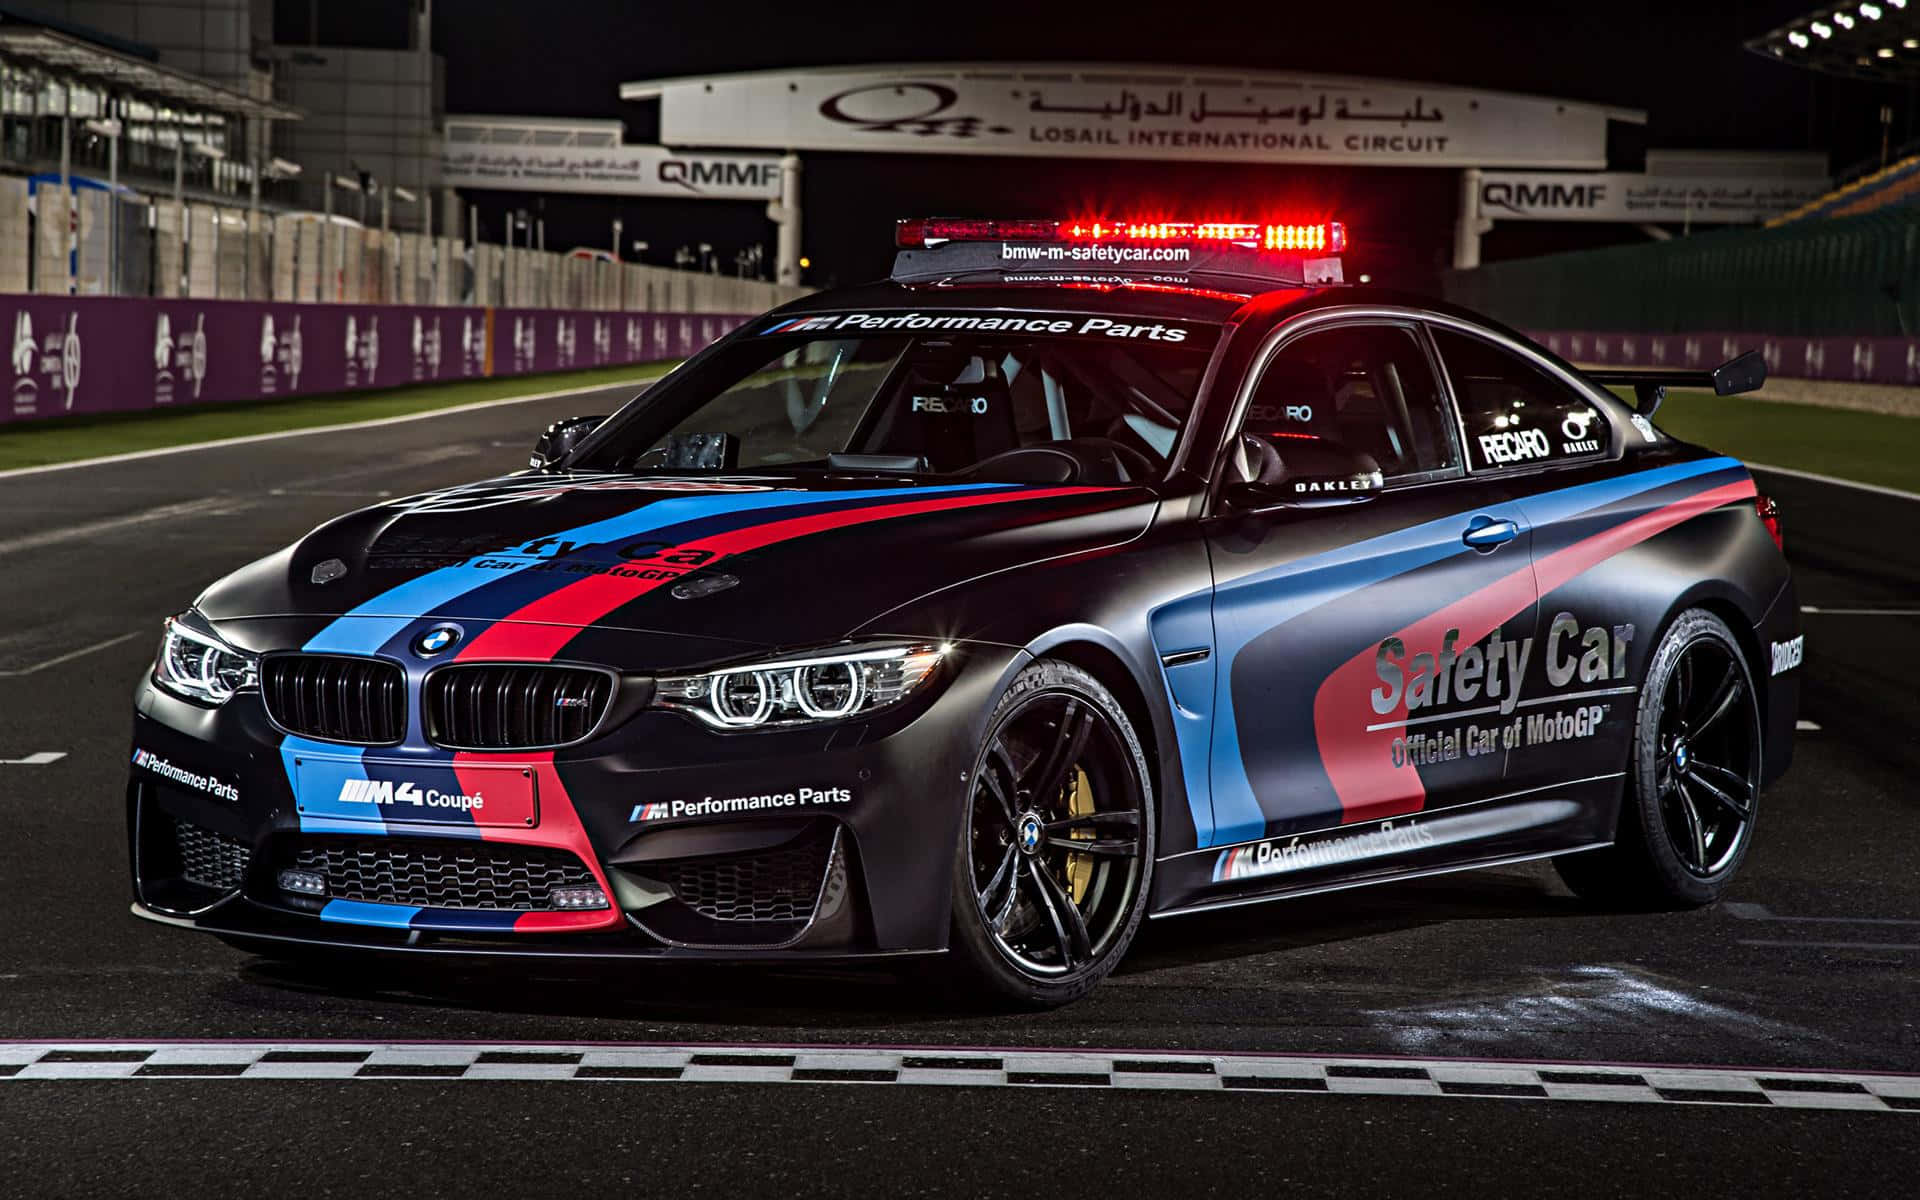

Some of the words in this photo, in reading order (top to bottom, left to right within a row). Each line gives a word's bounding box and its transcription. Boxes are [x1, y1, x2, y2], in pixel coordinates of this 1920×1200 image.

[1030, 126, 1119, 145] LOSAIL
[1128, 129, 1331, 150] INTERNATIONAL
[1344, 134, 1448, 152] CIRCUIT
[658, 161, 779, 192] QMMF
[1482, 184, 1607, 213] QMMF
[1002, 242, 1190, 264] bmw-m-safetycar.com
[834, 313, 1073, 333] Performance
[1078, 318, 1188, 342] Parts
[912, 396, 988, 414] REO
[1478, 428, 1550, 464] RECARO
[1562, 439, 1599, 454] OAKLEY
[1295, 480, 1372, 493] OAKLEY
[1371, 628, 1533, 715] Safety
[1546, 611, 1635, 687] Car
[1391, 727, 1461, 769] Official
[1466, 725, 1500, 757] Car
[1503, 715, 1523, 750] of
[147, 753, 207, 790] Performance
[207, 776, 239, 801] Parts
[426, 789, 485, 812] Coupé
[671, 792, 796, 817] Performance
[799, 787, 851, 805] Parts
[1257, 832, 1382, 868] Performance
[1381, 820, 1433, 846] Parts
